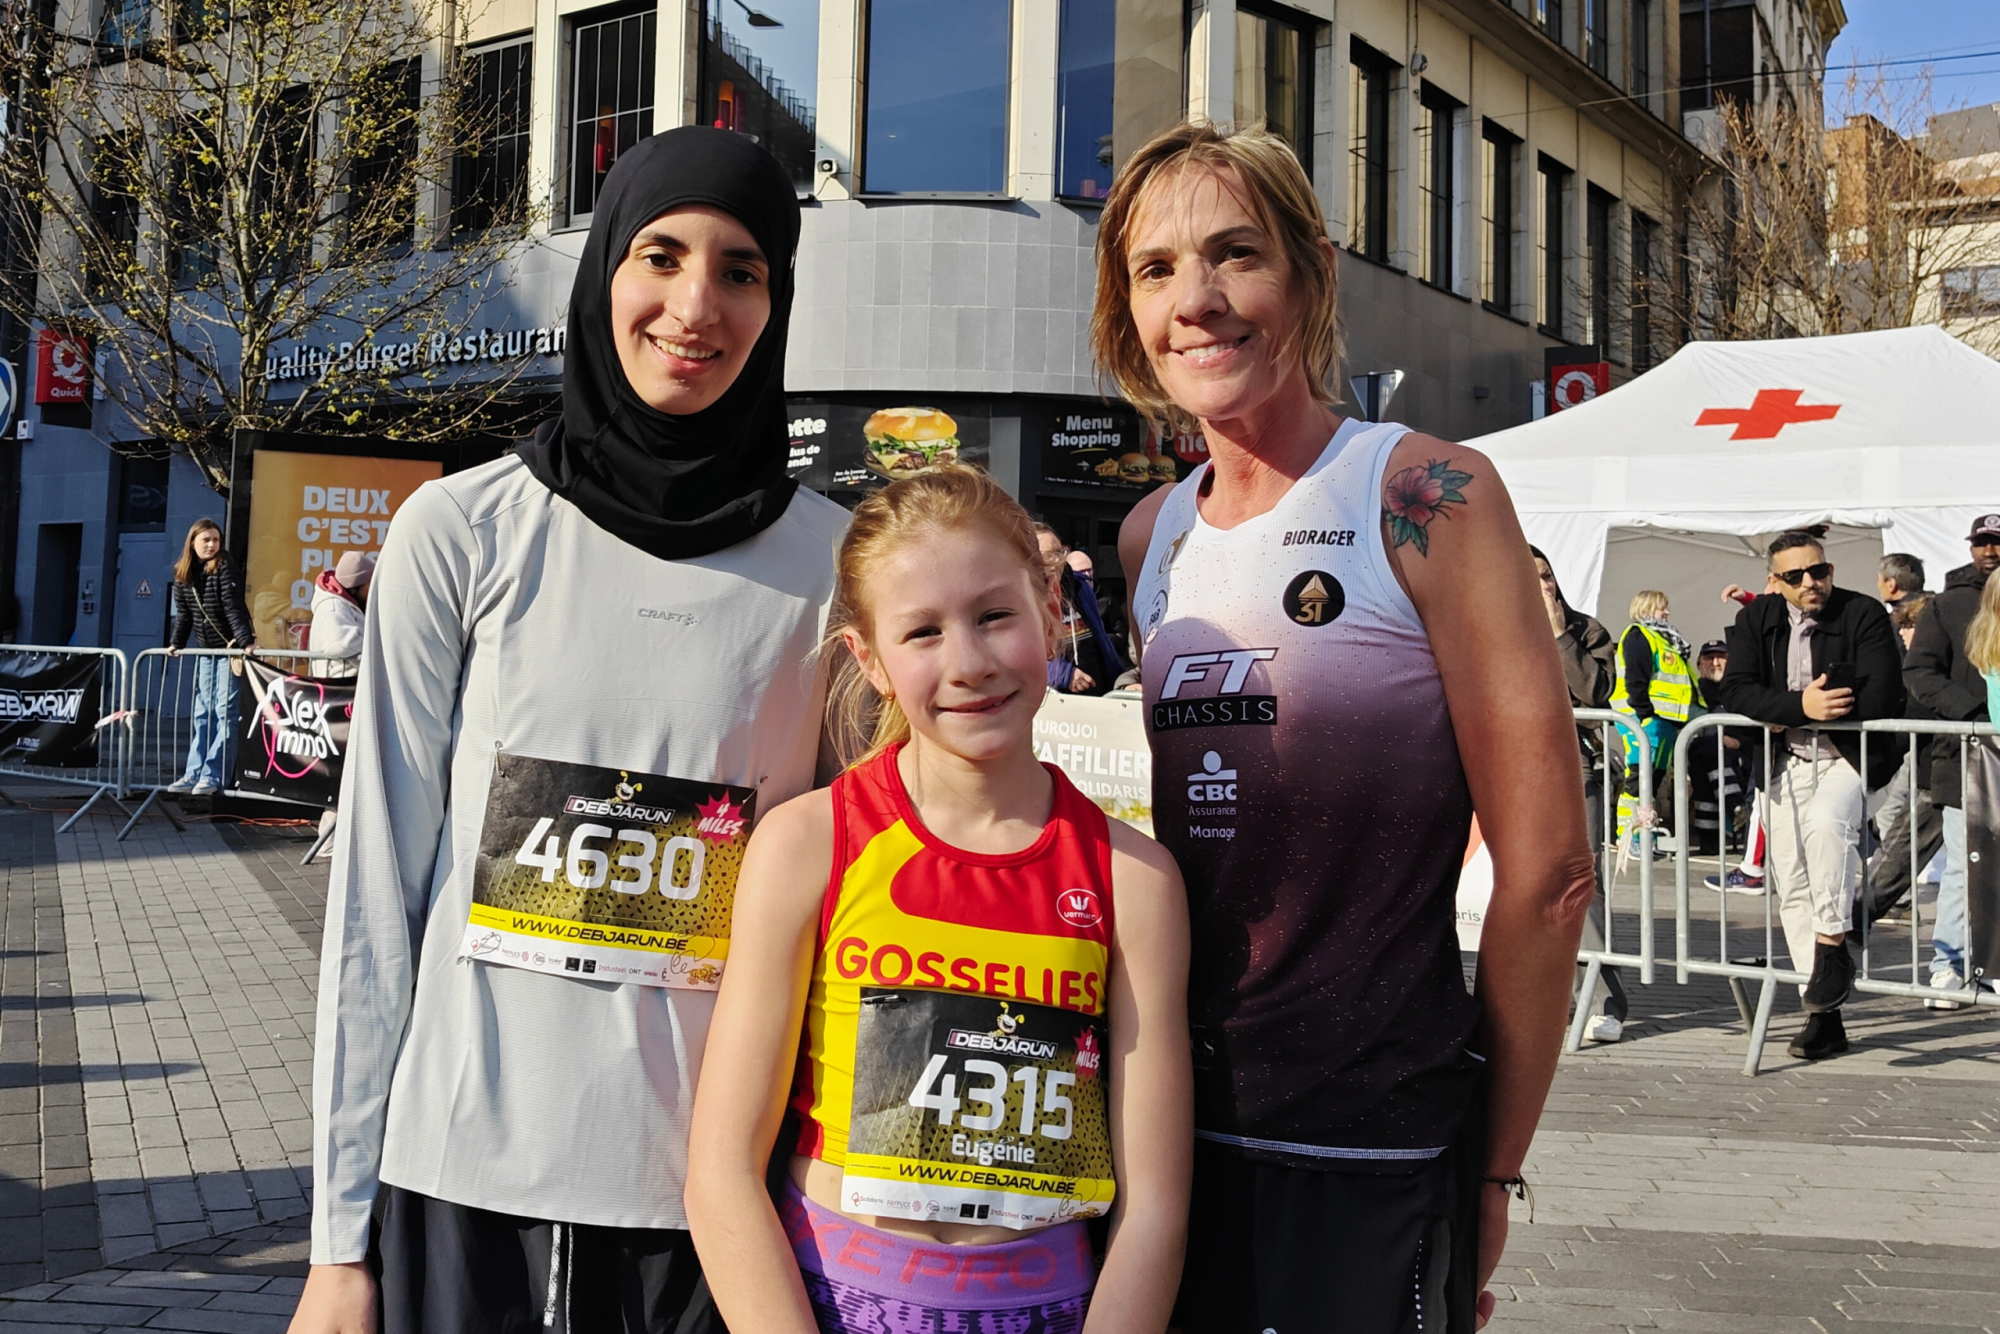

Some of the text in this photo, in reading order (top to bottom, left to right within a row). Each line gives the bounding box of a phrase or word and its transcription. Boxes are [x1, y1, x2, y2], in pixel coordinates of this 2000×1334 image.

[265, 325, 568, 381] uality Burger Restauran
[50, 387, 82, 398] Quick
[1066, 415, 1113, 432] Menu
[1051, 431, 1121, 448] Shopping
[303, 485, 391, 515] DEUX
[297, 516, 390, 546] C'EST
[1282, 530, 1356, 547] BIORACER
[637, 608, 686, 622] CRAFT
[1159, 647, 1279, 702] FT
[0, 694, 81, 718] EBJARUN
[1154, 700, 1275, 728] CHASSIS
[1077, 780, 1148, 800] OLIDARIS
[1187, 783, 1238, 801] CBC
[572, 800, 672, 825] DEBJARUN
[716, 802, 731, 818] 4
[1188, 805, 1237, 816] Assurances
[697, 816, 744, 836] MILES
[1189, 825, 1236, 841] Manage
[515, 816, 706, 901] 4630
[1064, 911, 1096, 921] vermarc
[512, 917, 689, 951] WWW.DEBJARUN.BE
[836, 936, 1099, 1014] GOSSELIES
[954, 1032, 1055, 1059] DEBJARUN
[1085, 1034, 1093, 1050] 4
[1075, 1050, 1100, 1070] MILES
[908, 1053, 1076, 1141] 4315
[951, 1132, 1036, 1166] Eugénie
[899, 1163, 1076, 1195] WWW.DEBJARUN.BE
[899, 1247, 1058, 1293] PRO
